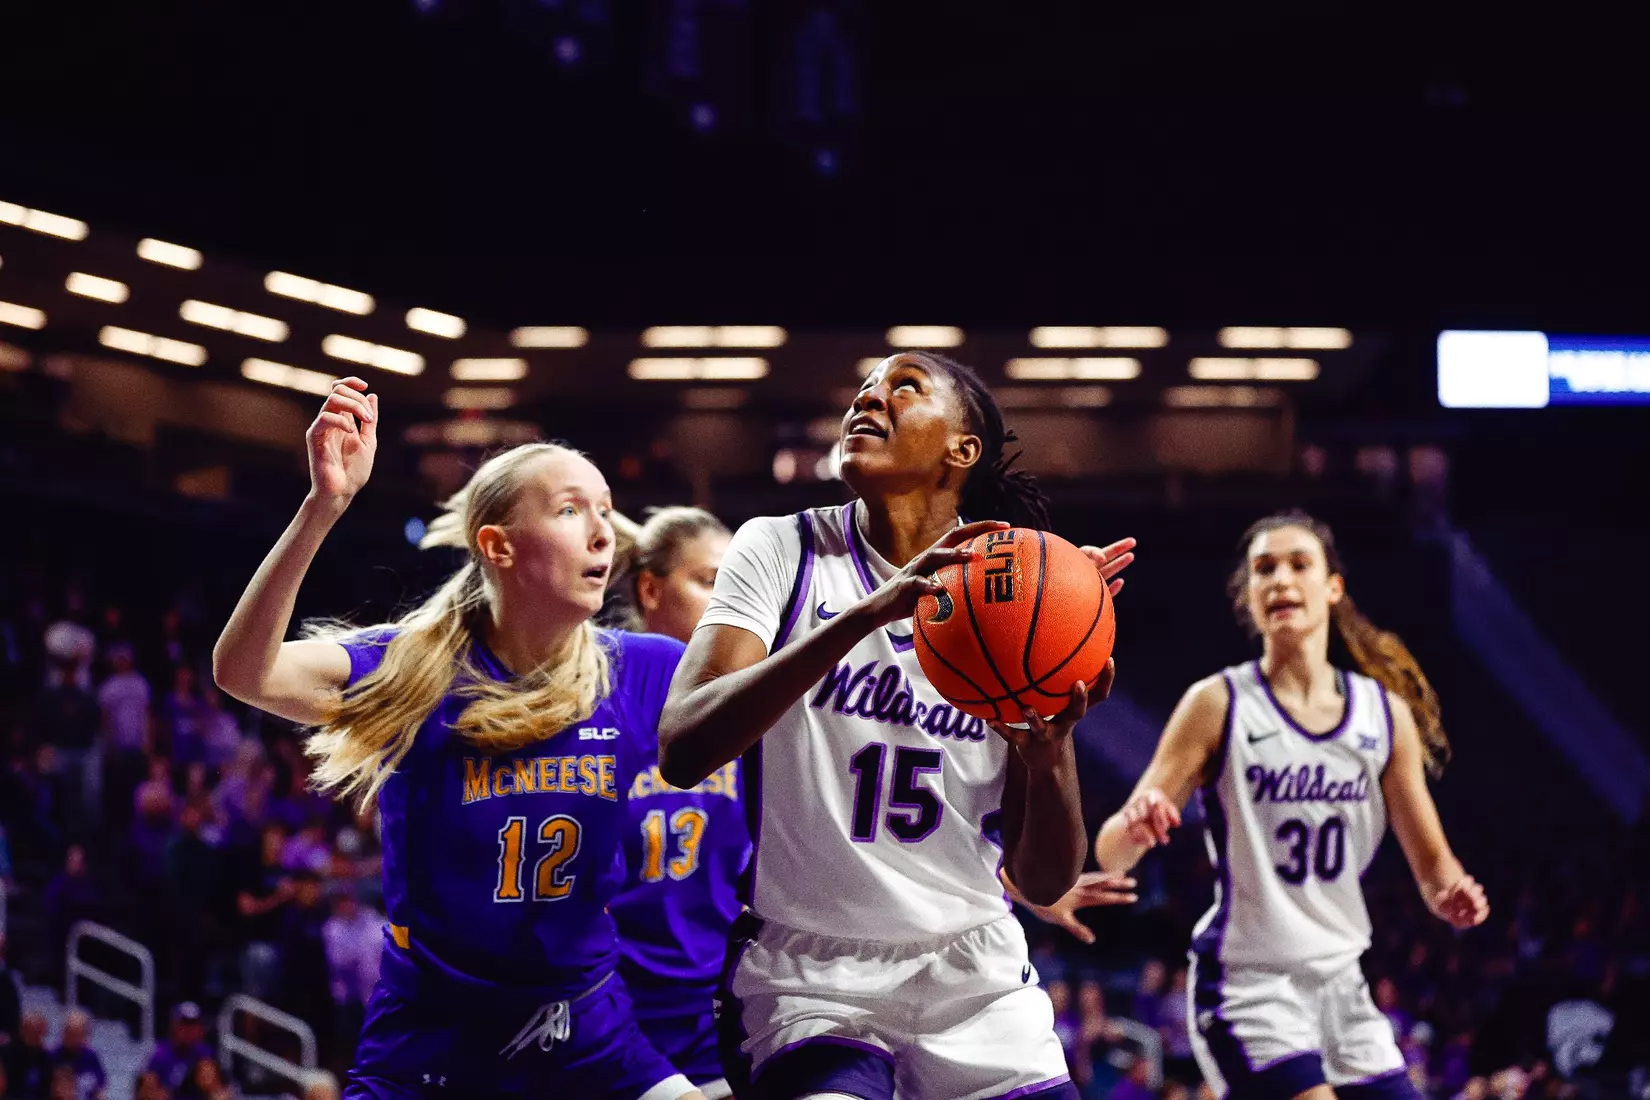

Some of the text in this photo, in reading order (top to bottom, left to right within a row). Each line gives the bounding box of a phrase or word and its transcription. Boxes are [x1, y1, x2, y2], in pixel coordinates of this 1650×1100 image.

[985, 530, 1015, 604] ELITE
[578, 727, 620, 740] SLC
[849, 741, 944, 843] 15
[493, 814, 582, 903] 12
[640, 806, 709, 883] 13
[1274, 816, 1345, 886] 30
